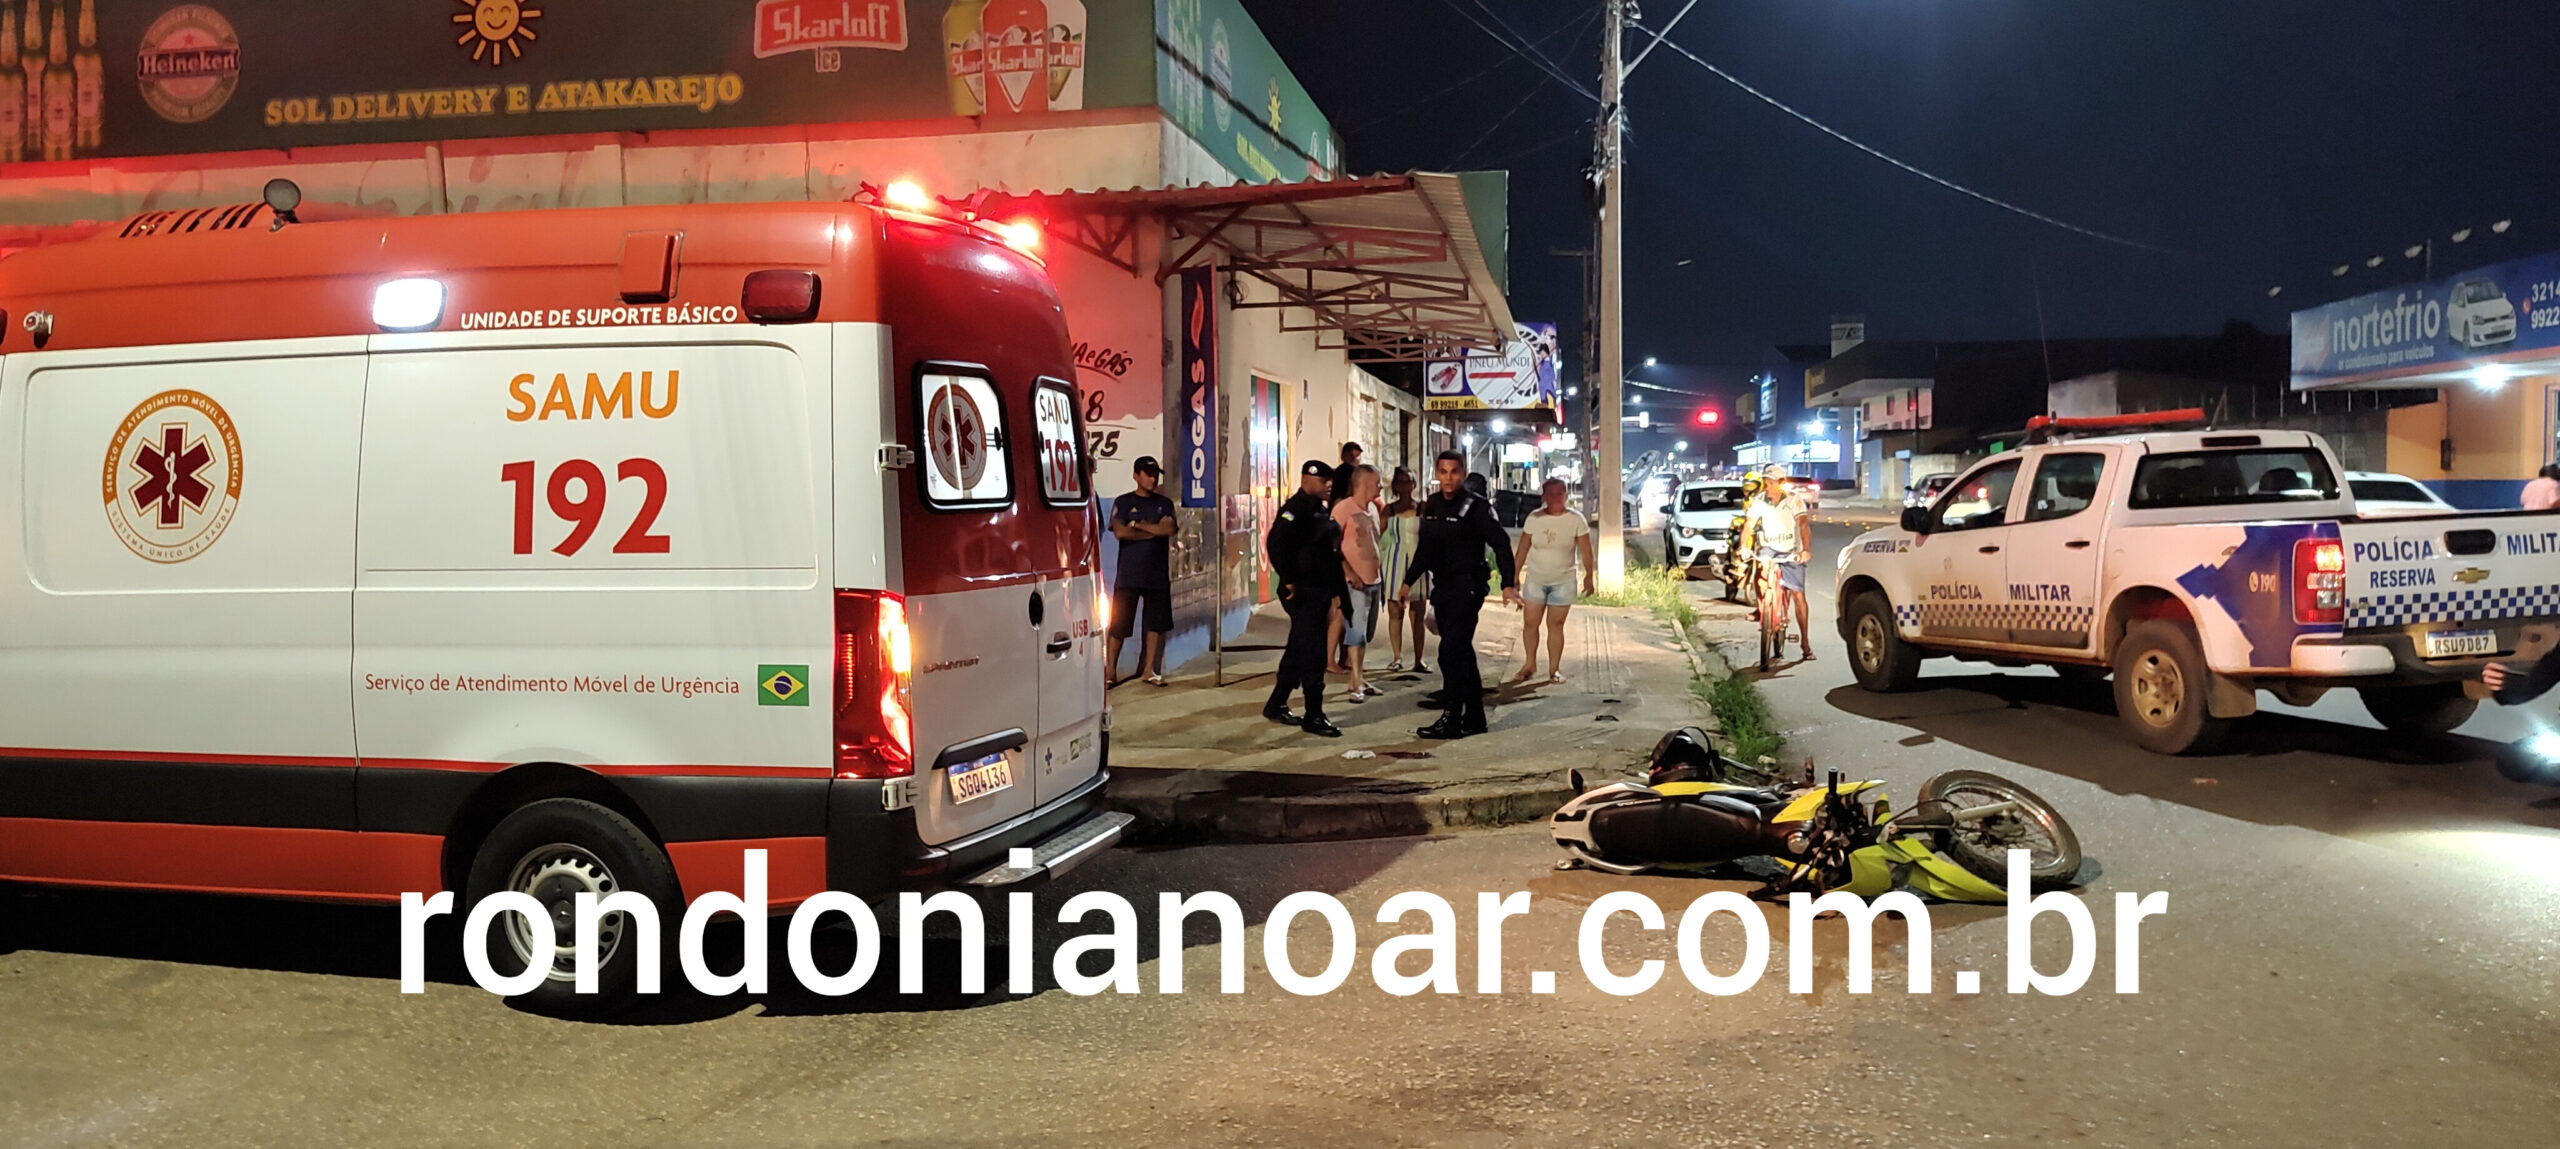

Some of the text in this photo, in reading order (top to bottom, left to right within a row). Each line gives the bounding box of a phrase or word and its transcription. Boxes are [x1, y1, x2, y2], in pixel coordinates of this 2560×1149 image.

[773, 4, 889, 45] Skarloff
[143, 50, 236, 75] Heineken
[815, 47, 841, 72] Ice
[265, 98, 326, 126] SOL
[331, 87, 498, 120] DELIVERY
[505, 85, 529, 113] E
[537, 74, 743, 112] ATAKAREJO
[461, 302, 738, 330] UNIDADE DE SUPORTE BÁSICO
[2333, 290, 2441, 353] nortefrio
[1497, 356, 1531, 369] MUNDI
[506, 370, 679, 422] SAMU
[1039, 394, 1070, 425] SAMU
[106, 394, 240, 493] SERVIÇO DE ATENDIMENTO MÓVEL DE URGÊNCIA
[1045, 438, 1078, 493] 192
[501, 457, 671, 557] 192
[112, 507, 231, 559] SISTEMA ÚNICO DE SAÚDE
[2354, 533, 2560, 562] POLÍCIA MILIT
[1930, 580, 2071, 602] POLÍCIA MILITAR
[2260, 573, 2276, 592] 190
[2370, 568, 2435, 588] RESERVA
[1072, 618, 1088, 639] USB
[2434, 636, 2489, 654] RSU9D87
[365, 673, 740, 699] Serviço de Atendimento Móvel de Urgência
